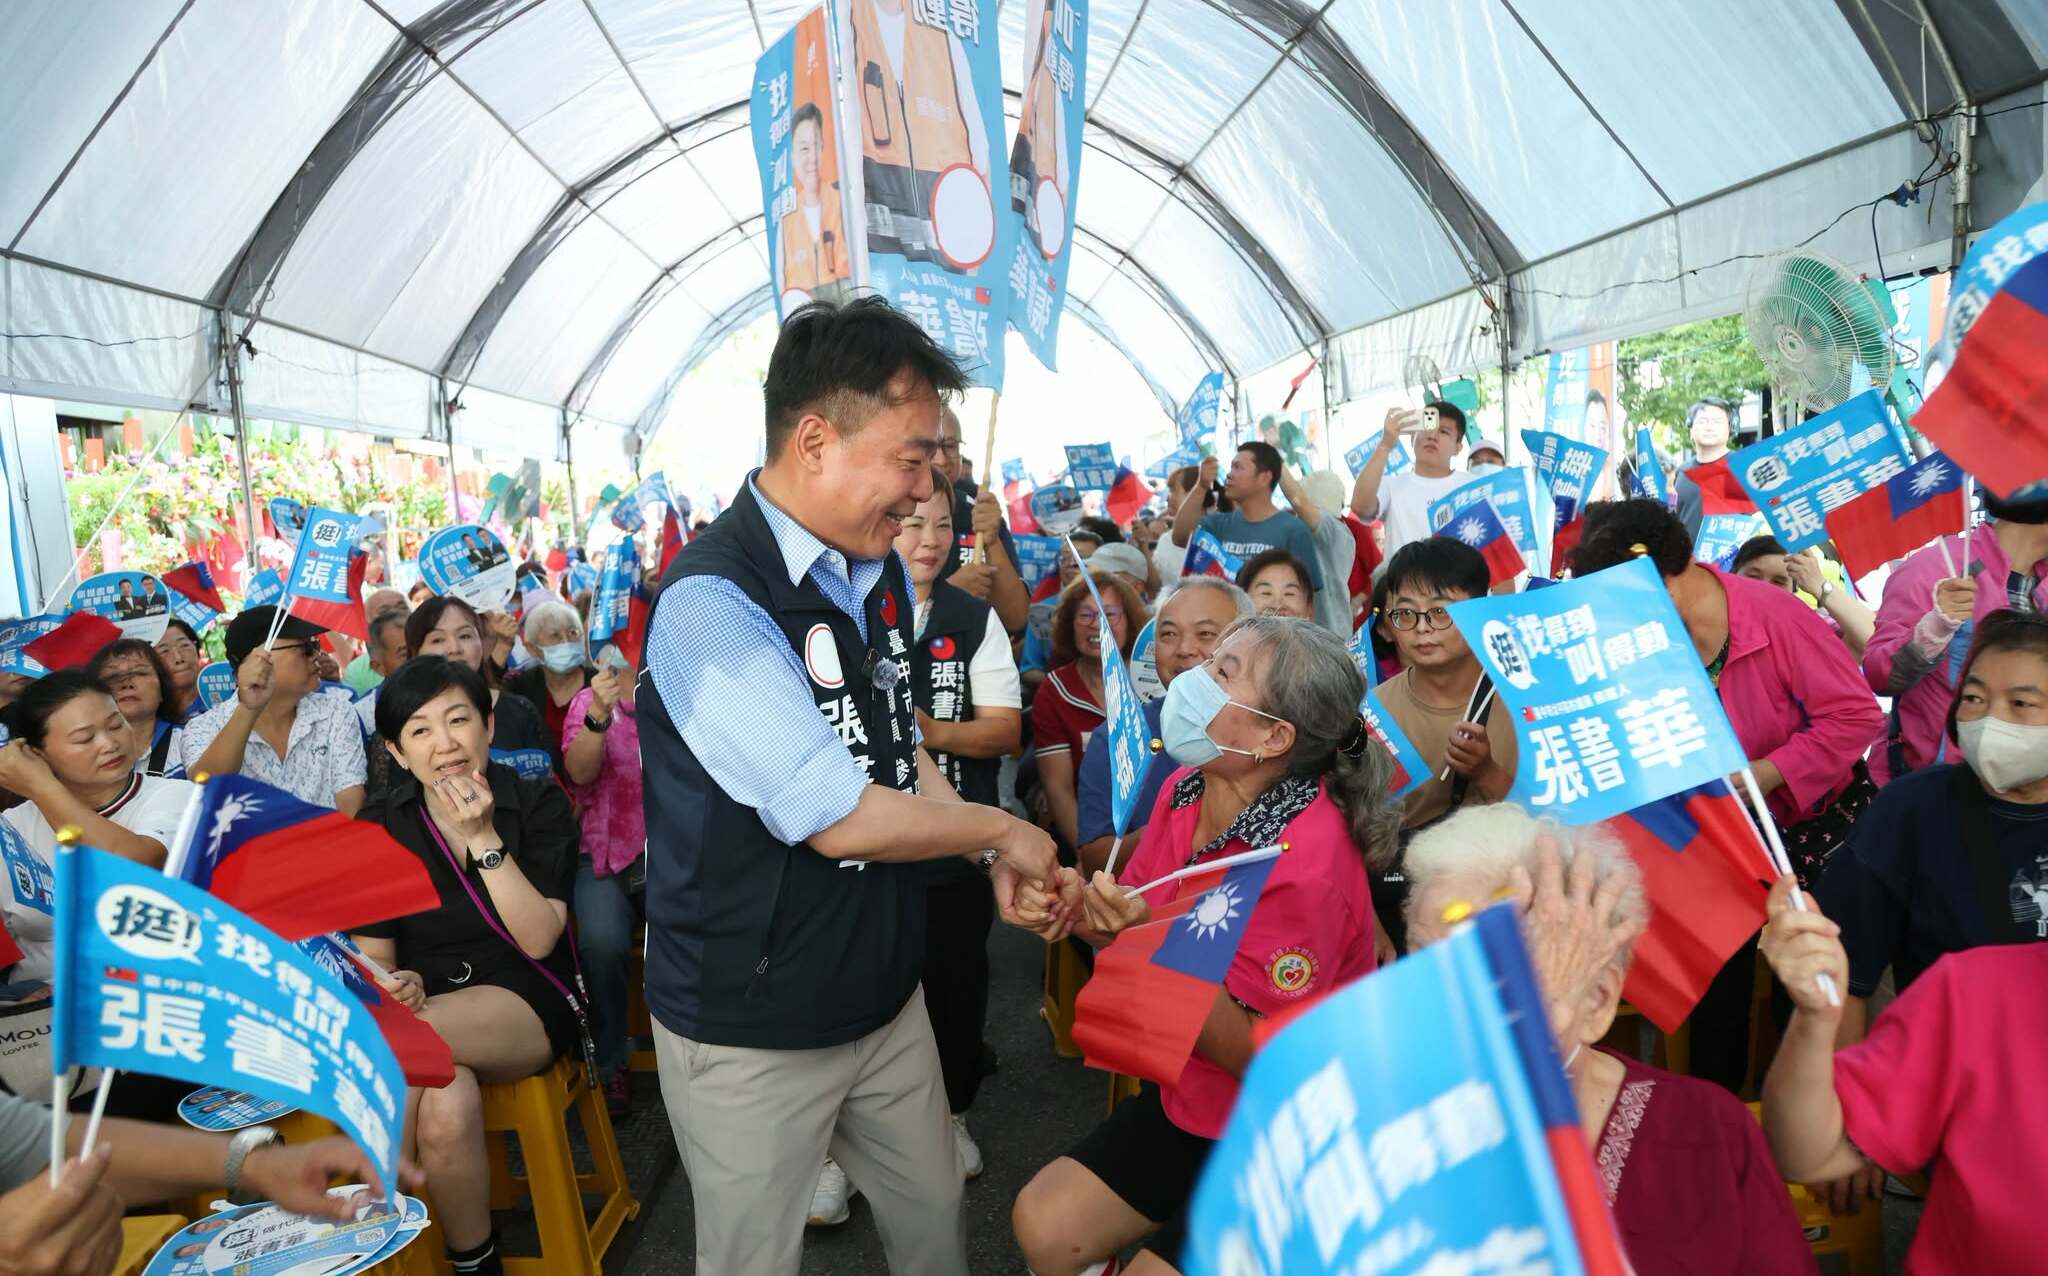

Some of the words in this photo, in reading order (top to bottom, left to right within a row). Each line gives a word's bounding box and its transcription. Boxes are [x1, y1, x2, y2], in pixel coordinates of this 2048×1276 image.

[1772, 453, 1907, 543] 張書華
[1516, 603, 1597, 660] 找得到
[1564, 620, 1670, 685] 叫得動
[1528, 687, 1707, 806] 張書華
[110, 895, 198, 948] 挺!
